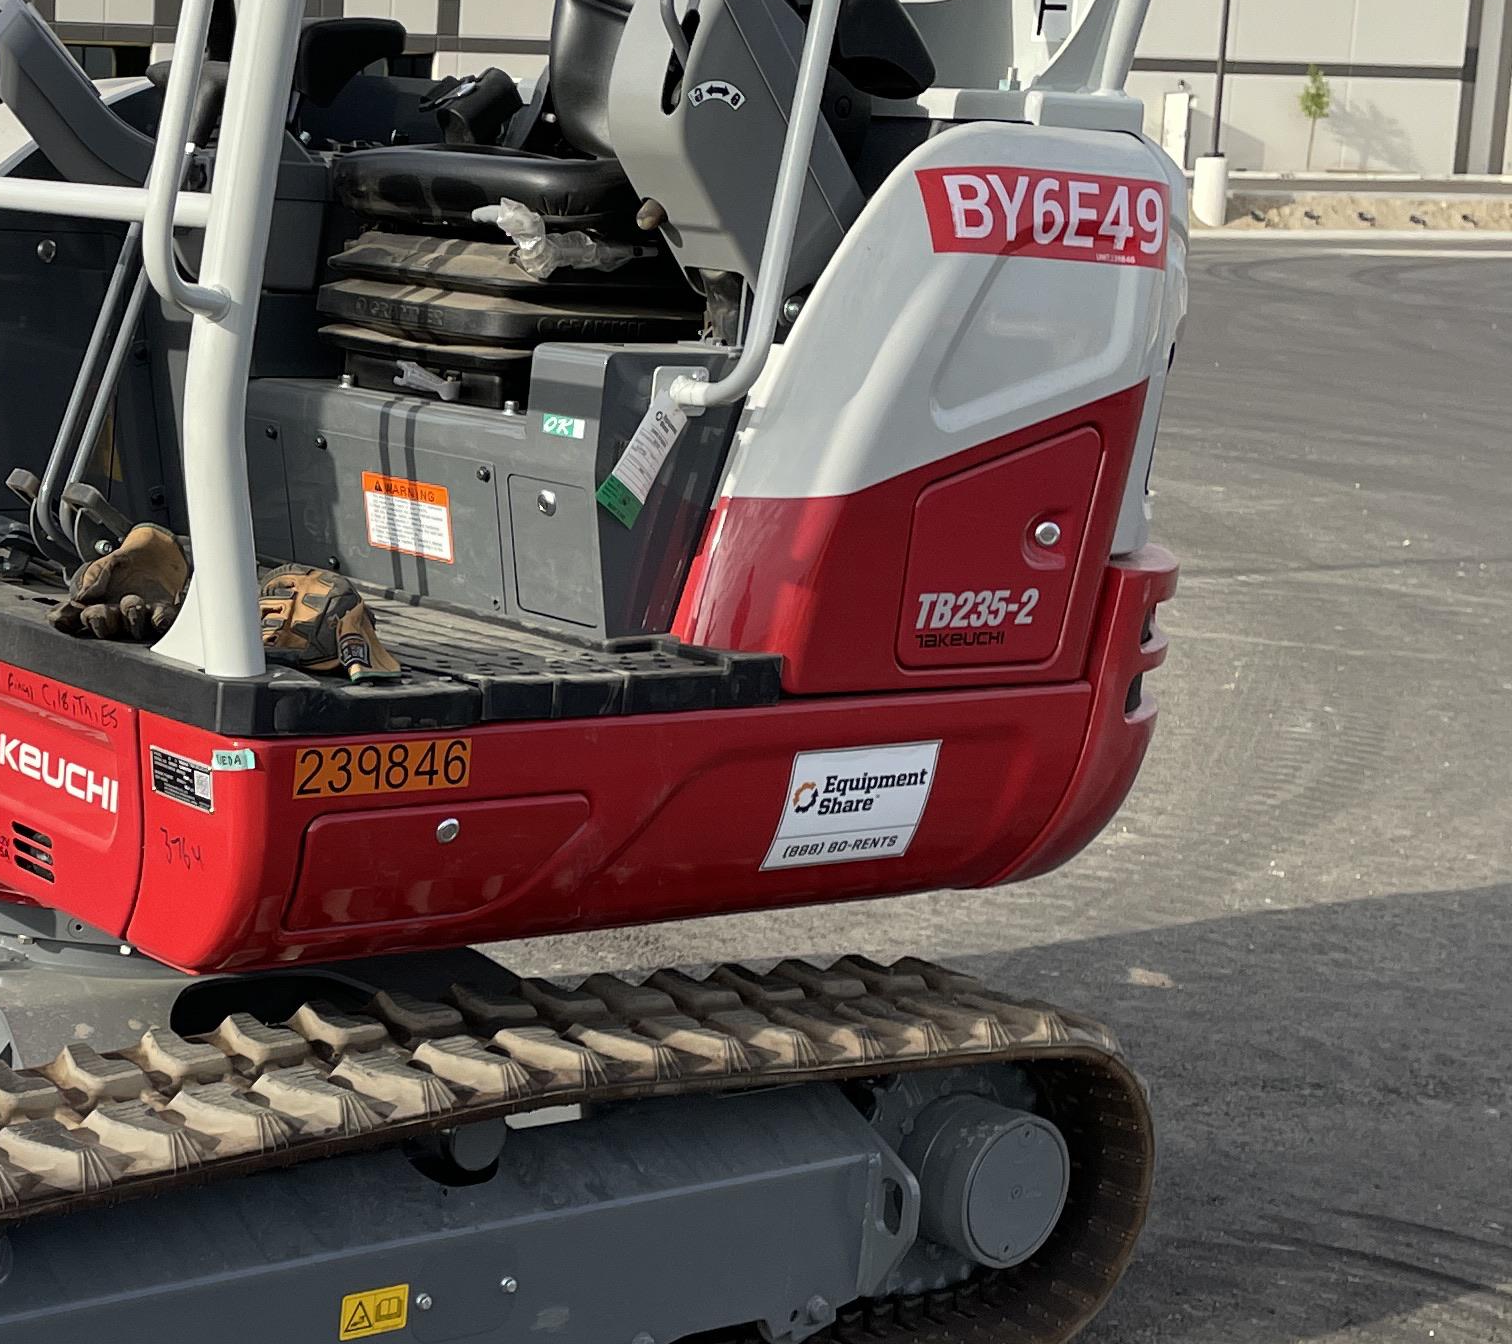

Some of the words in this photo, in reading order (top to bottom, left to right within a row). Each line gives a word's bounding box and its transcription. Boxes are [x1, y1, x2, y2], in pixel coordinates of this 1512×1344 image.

[942, 174, 1164, 254] BY6E49
[543, 416, 574, 435] OK
[384, 482, 436, 502] WARNING
[914, 588, 1040, 630] TB235-2
[914, 630, 1006, 649] TAKEUCHI
[295, 739, 469, 797] 239846
[823, 768, 928, 796] Equipment
[817, 796, 875, 816] Share
[782, 841, 825, 858] (888)
